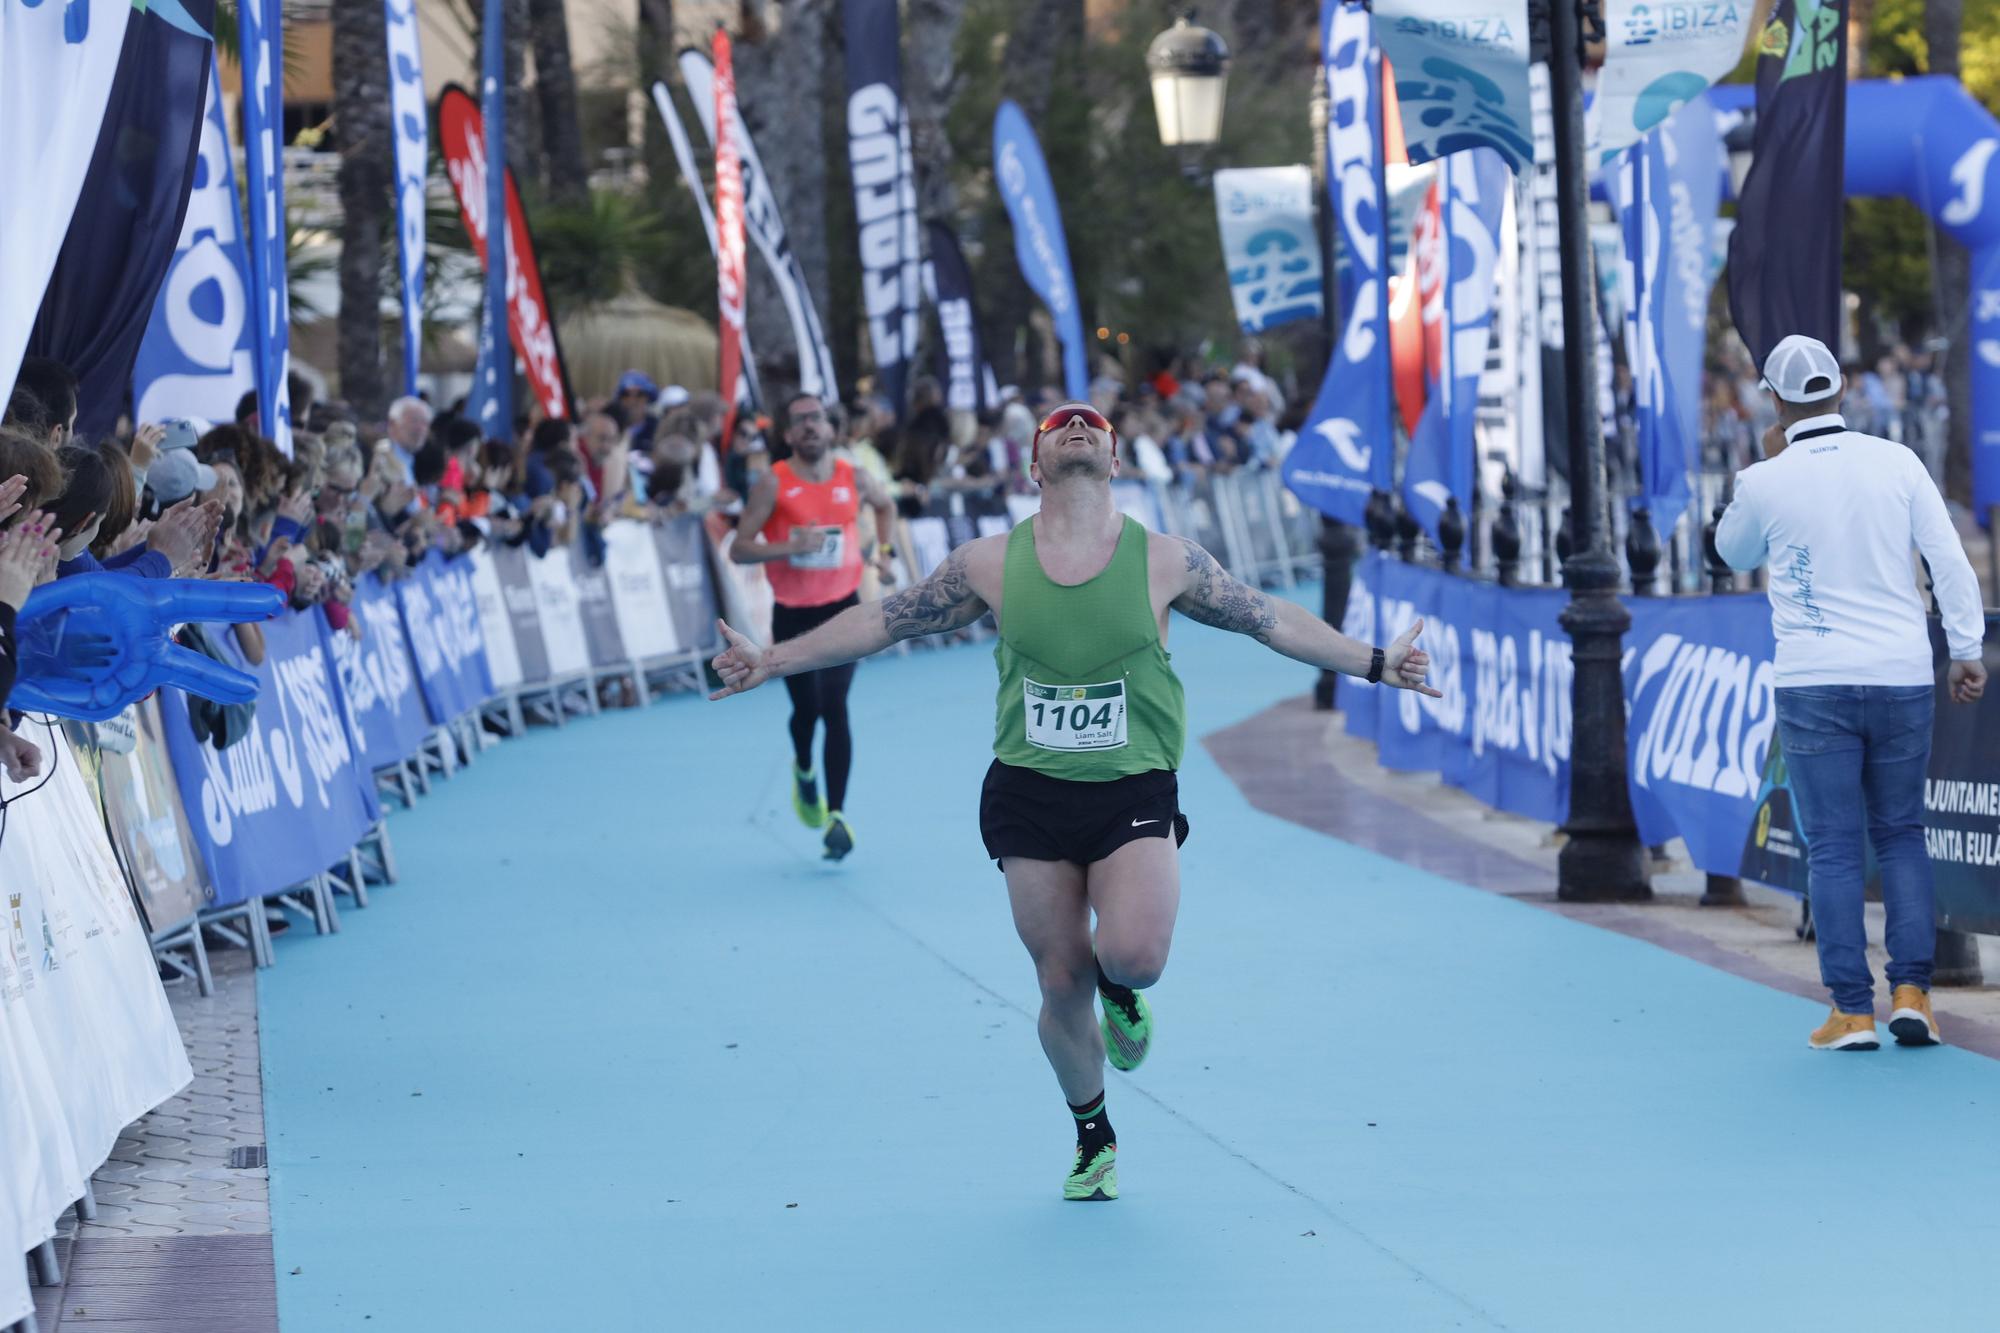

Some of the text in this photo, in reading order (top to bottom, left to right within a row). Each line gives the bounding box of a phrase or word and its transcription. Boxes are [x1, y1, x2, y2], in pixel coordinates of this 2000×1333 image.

[1661, 1, 1739, 31] IBIZA
[1431, 20, 1514, 42] IBIZA
[1032, 702, 1112, 731] 1104
[1075, 730, 1113, 740] Liam Salt
[1924, 778, 2000, 817] AJUNTAME
[1924, 826, 1964, 862] SANTA
